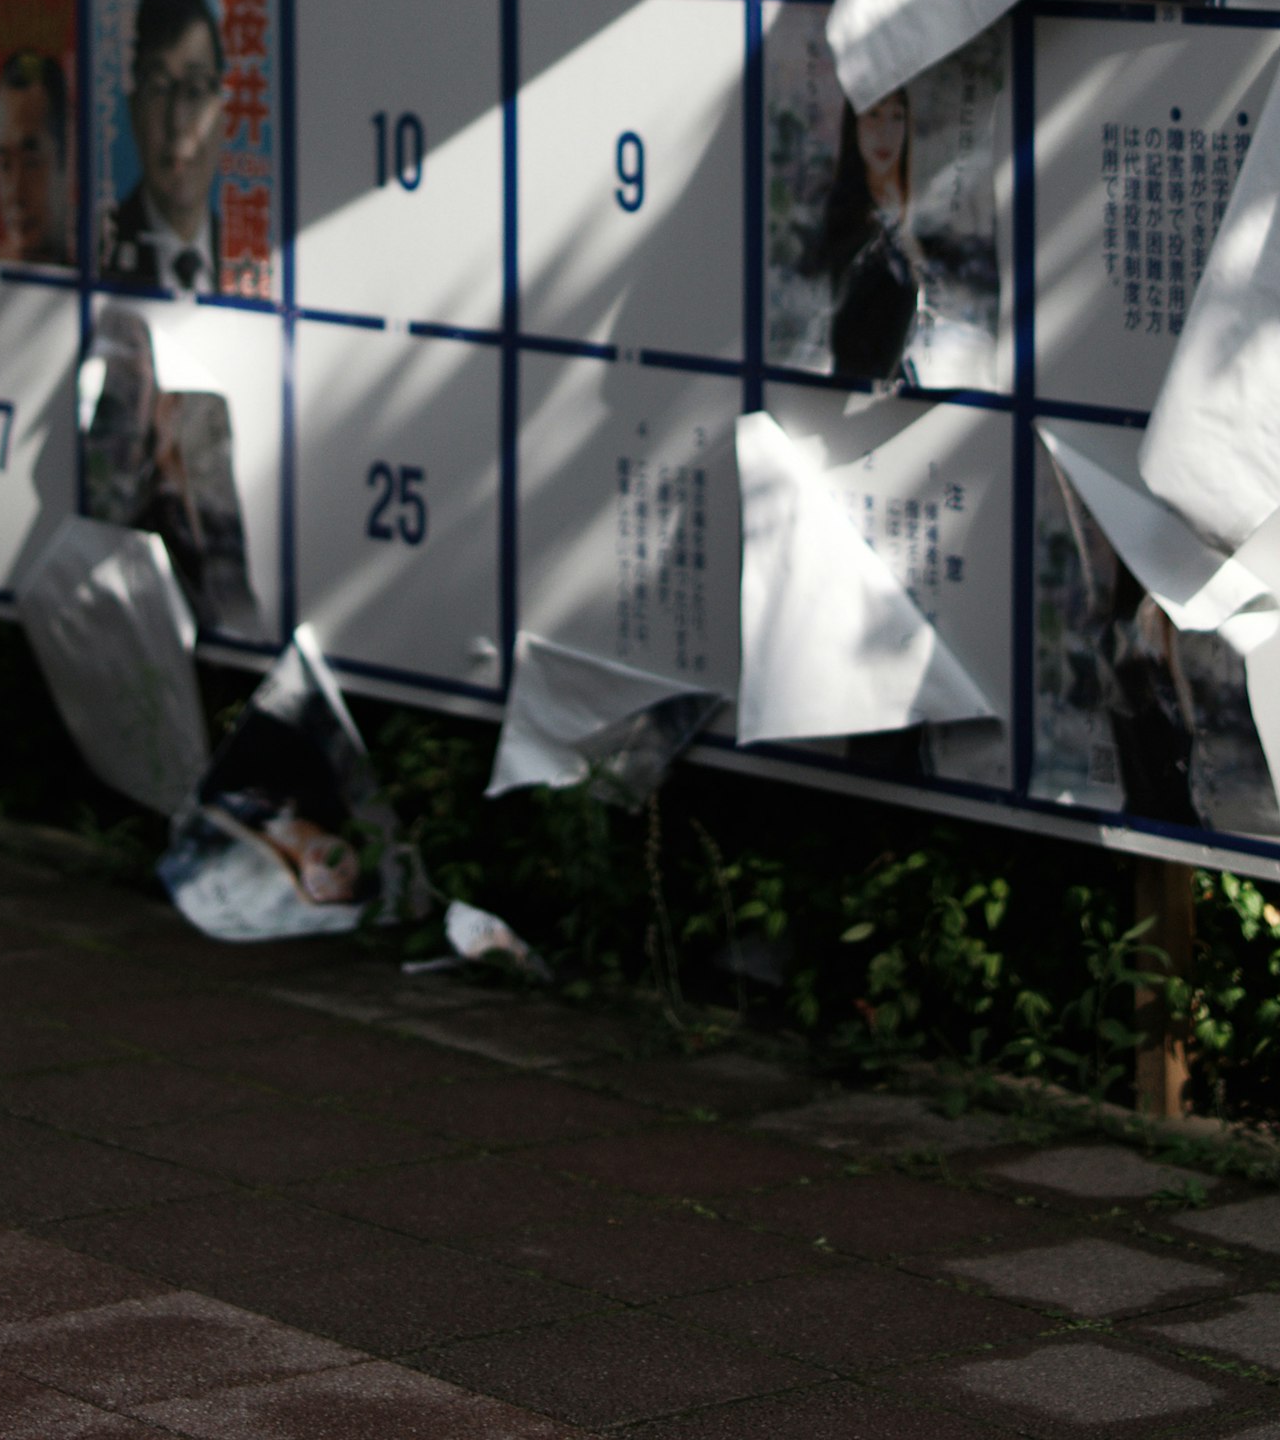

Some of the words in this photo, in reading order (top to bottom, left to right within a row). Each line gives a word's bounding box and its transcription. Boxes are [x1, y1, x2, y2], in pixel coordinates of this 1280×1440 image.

[370, 113, 422, 193] 10
[616, 130, 650, 210] 9
[368, 461, 425, 544] 25
